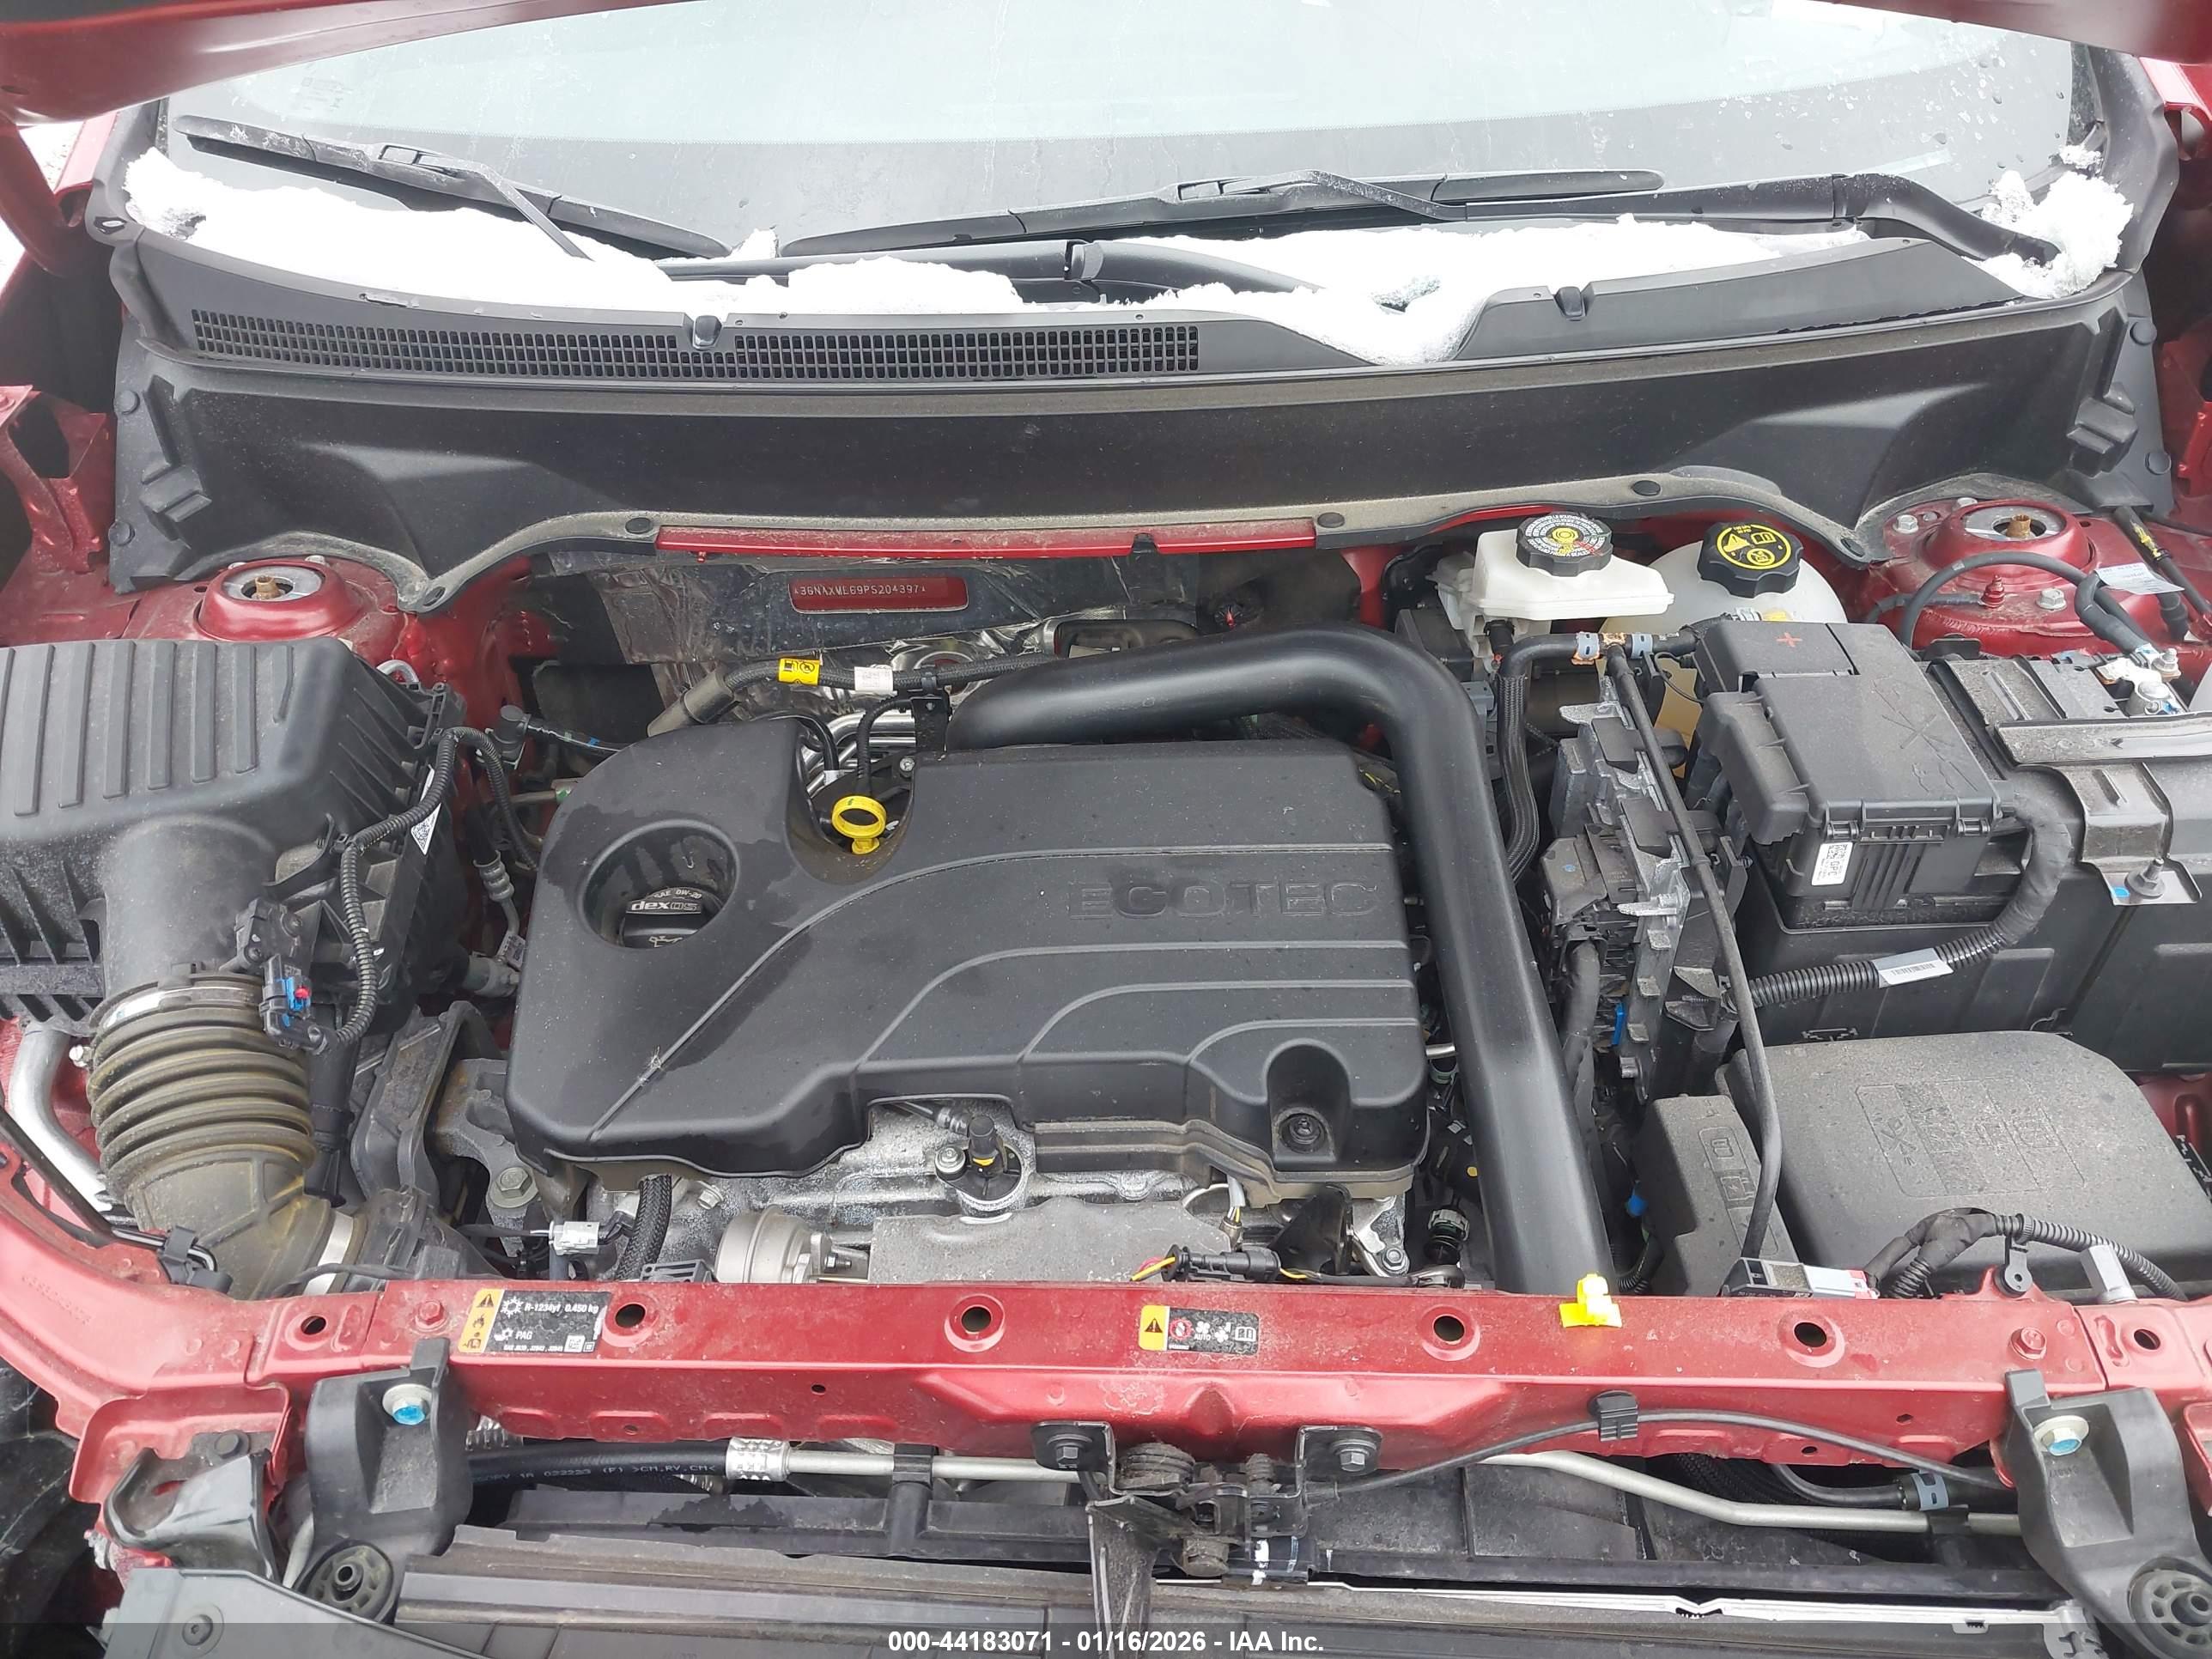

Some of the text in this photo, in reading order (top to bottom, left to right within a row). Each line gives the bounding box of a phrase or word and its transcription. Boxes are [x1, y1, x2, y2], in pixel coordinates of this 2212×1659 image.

[676, 889, 702, 899] 0W-20
[1067, 879, 1376, 919] ECOTEC
[631, 901, 698, 911] dexos
[588, 1303, 599, 1315] kg
[515, 1331, 533, 1340] PAG
